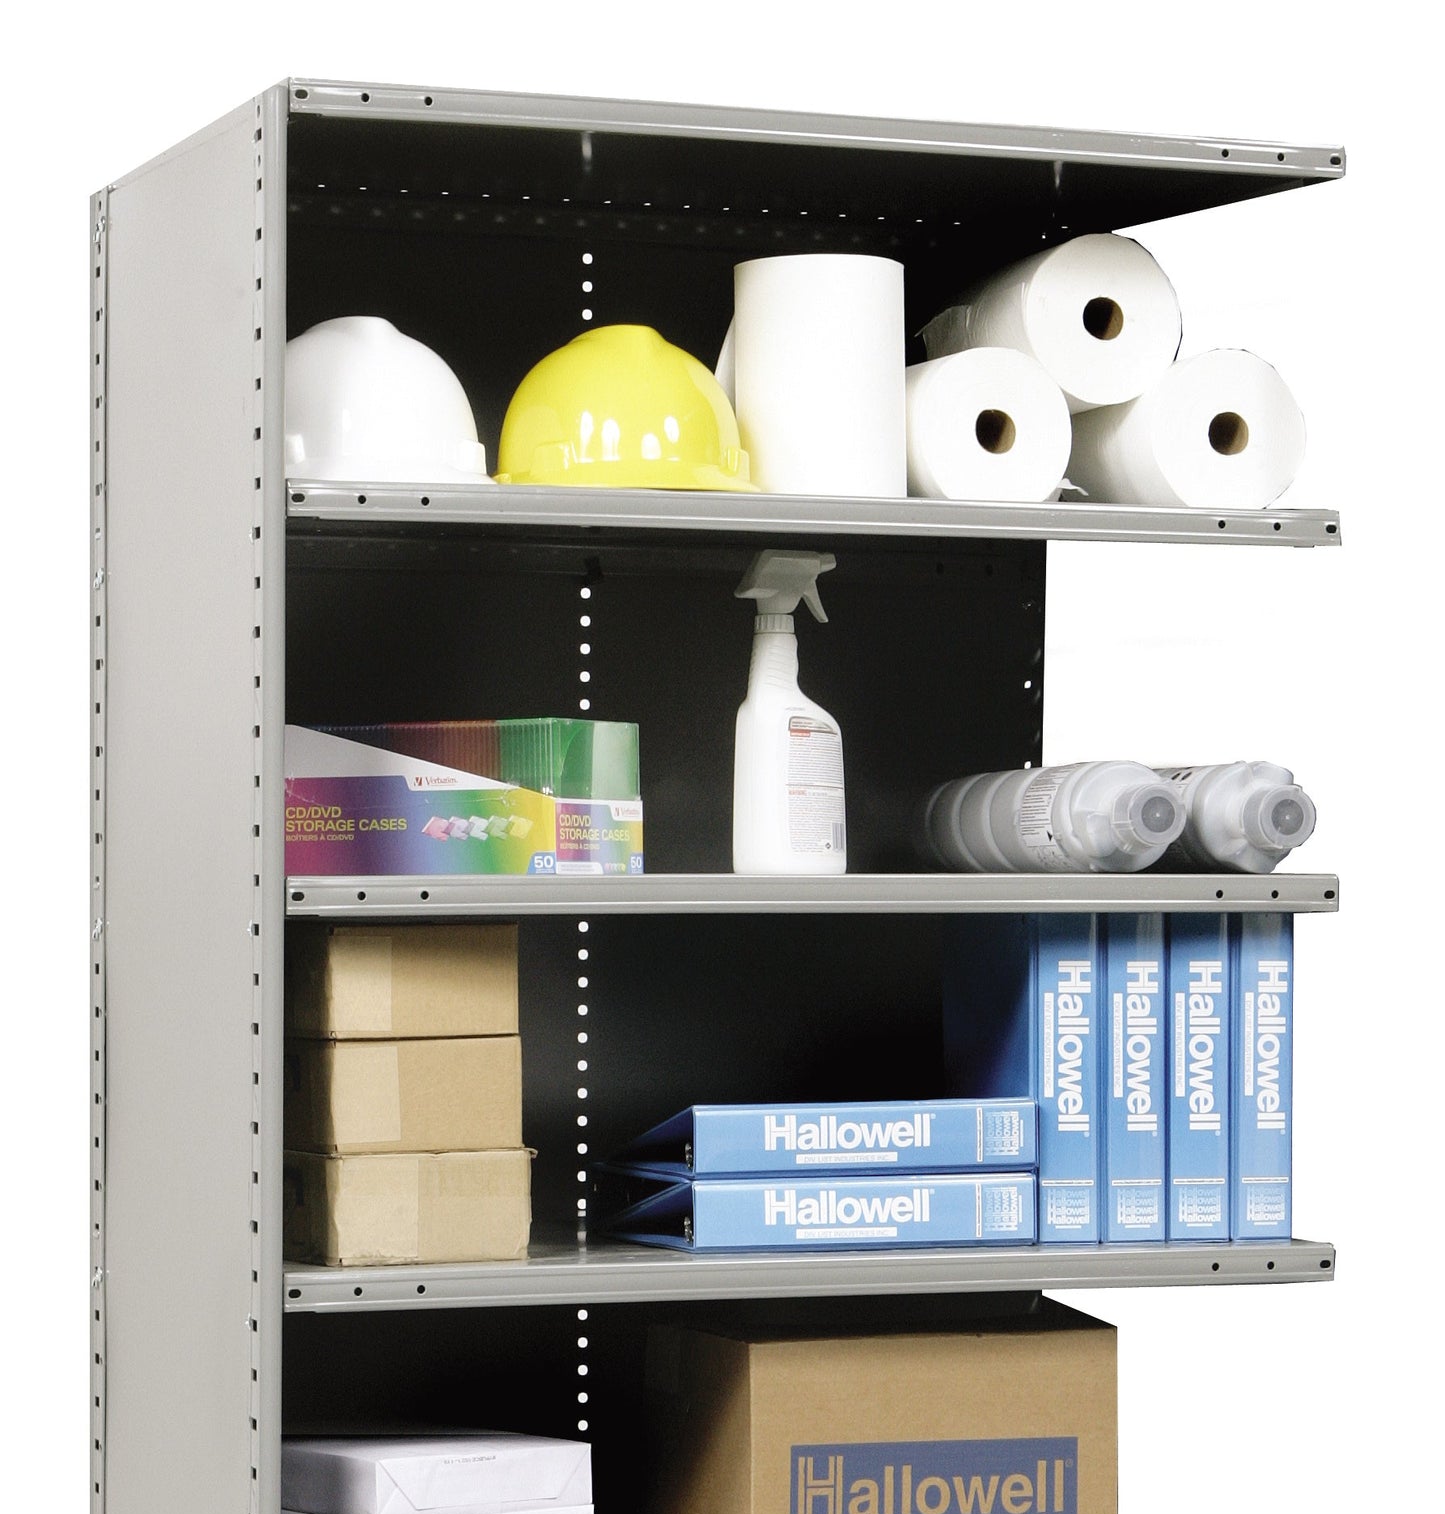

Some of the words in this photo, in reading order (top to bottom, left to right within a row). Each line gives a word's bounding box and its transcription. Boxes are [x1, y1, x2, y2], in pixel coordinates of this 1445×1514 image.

[285, 806, 342, 819] CD/DVD
[285, 819, 355, 832] STORAGE
[359, 818, 407, 831] CASES
[559, 814, 591, 827] CD/DVD
[560, 828, 600, 840] STORAGE
[602, 829, 630, 841] CASES
[534, 855, 554, 868] 50
[1057, 960, 1091, 1131] Hallowell
[1127, 960, 1159, 1131] Hallowell
[1189, 960, 1222, 1131] Hallowell
[1257, 960, 1288, 1130] Hallowell
[764, 1113, 931, 1151] Hallowell
[764, 1188, 930, 1226] Hallowell
